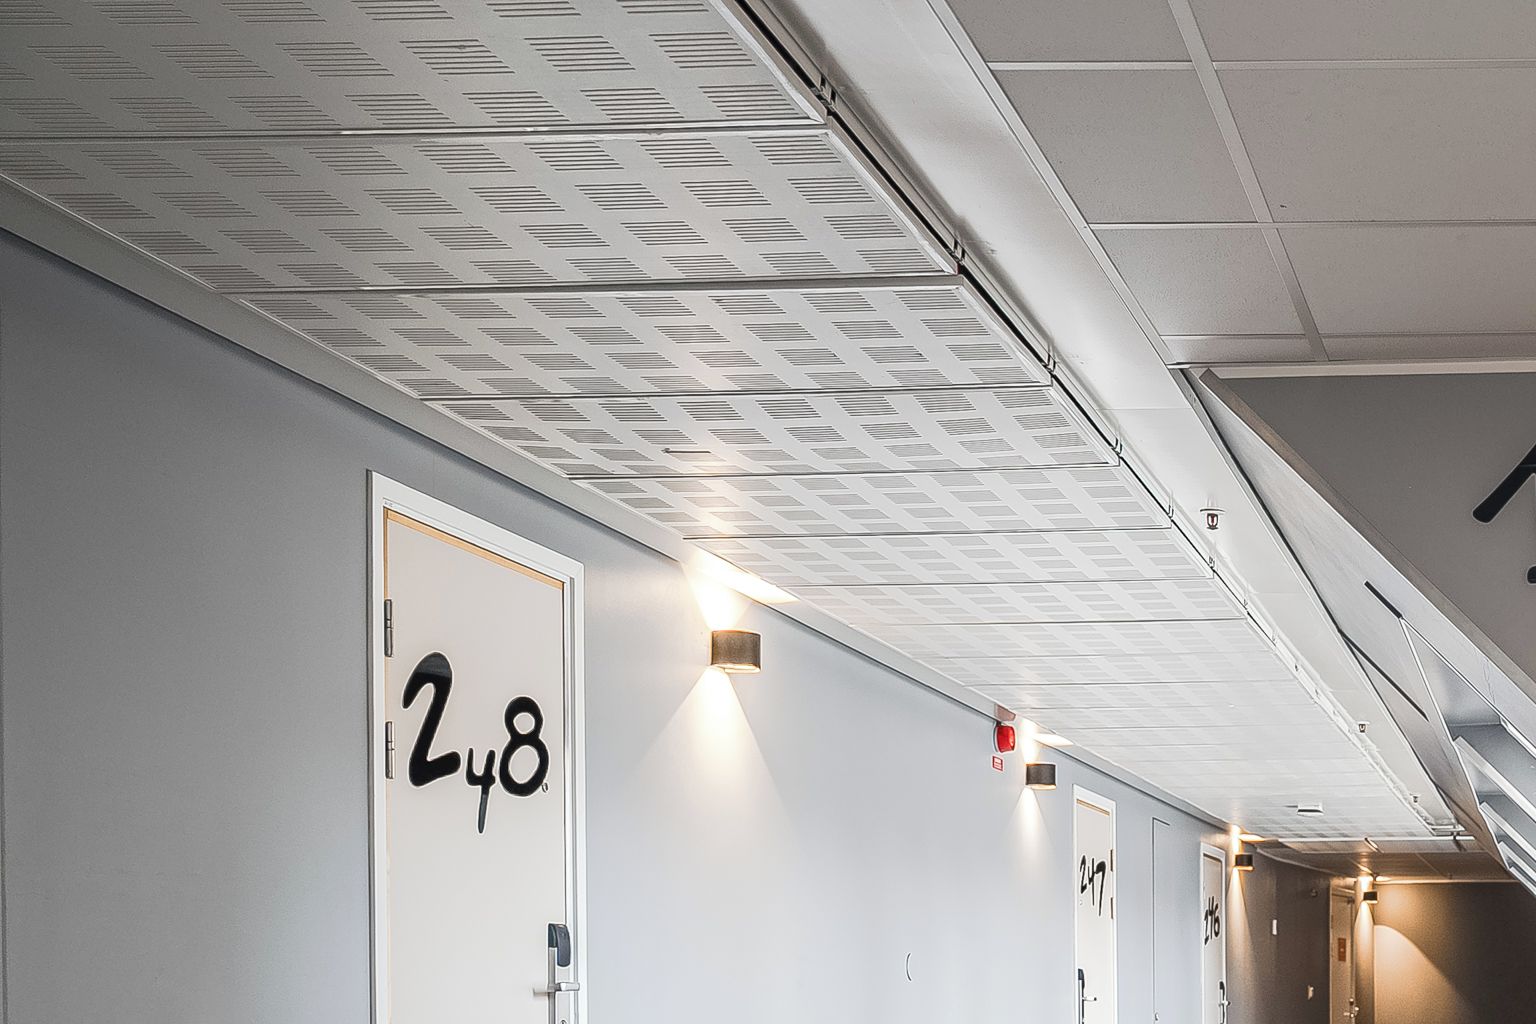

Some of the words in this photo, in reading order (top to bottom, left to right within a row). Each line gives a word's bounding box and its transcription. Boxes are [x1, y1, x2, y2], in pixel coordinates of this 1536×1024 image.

[402, 651, 549, 834] 248
[1079, 854, 1107, 917] 247
[1203, 895, 1221, 946] 246
